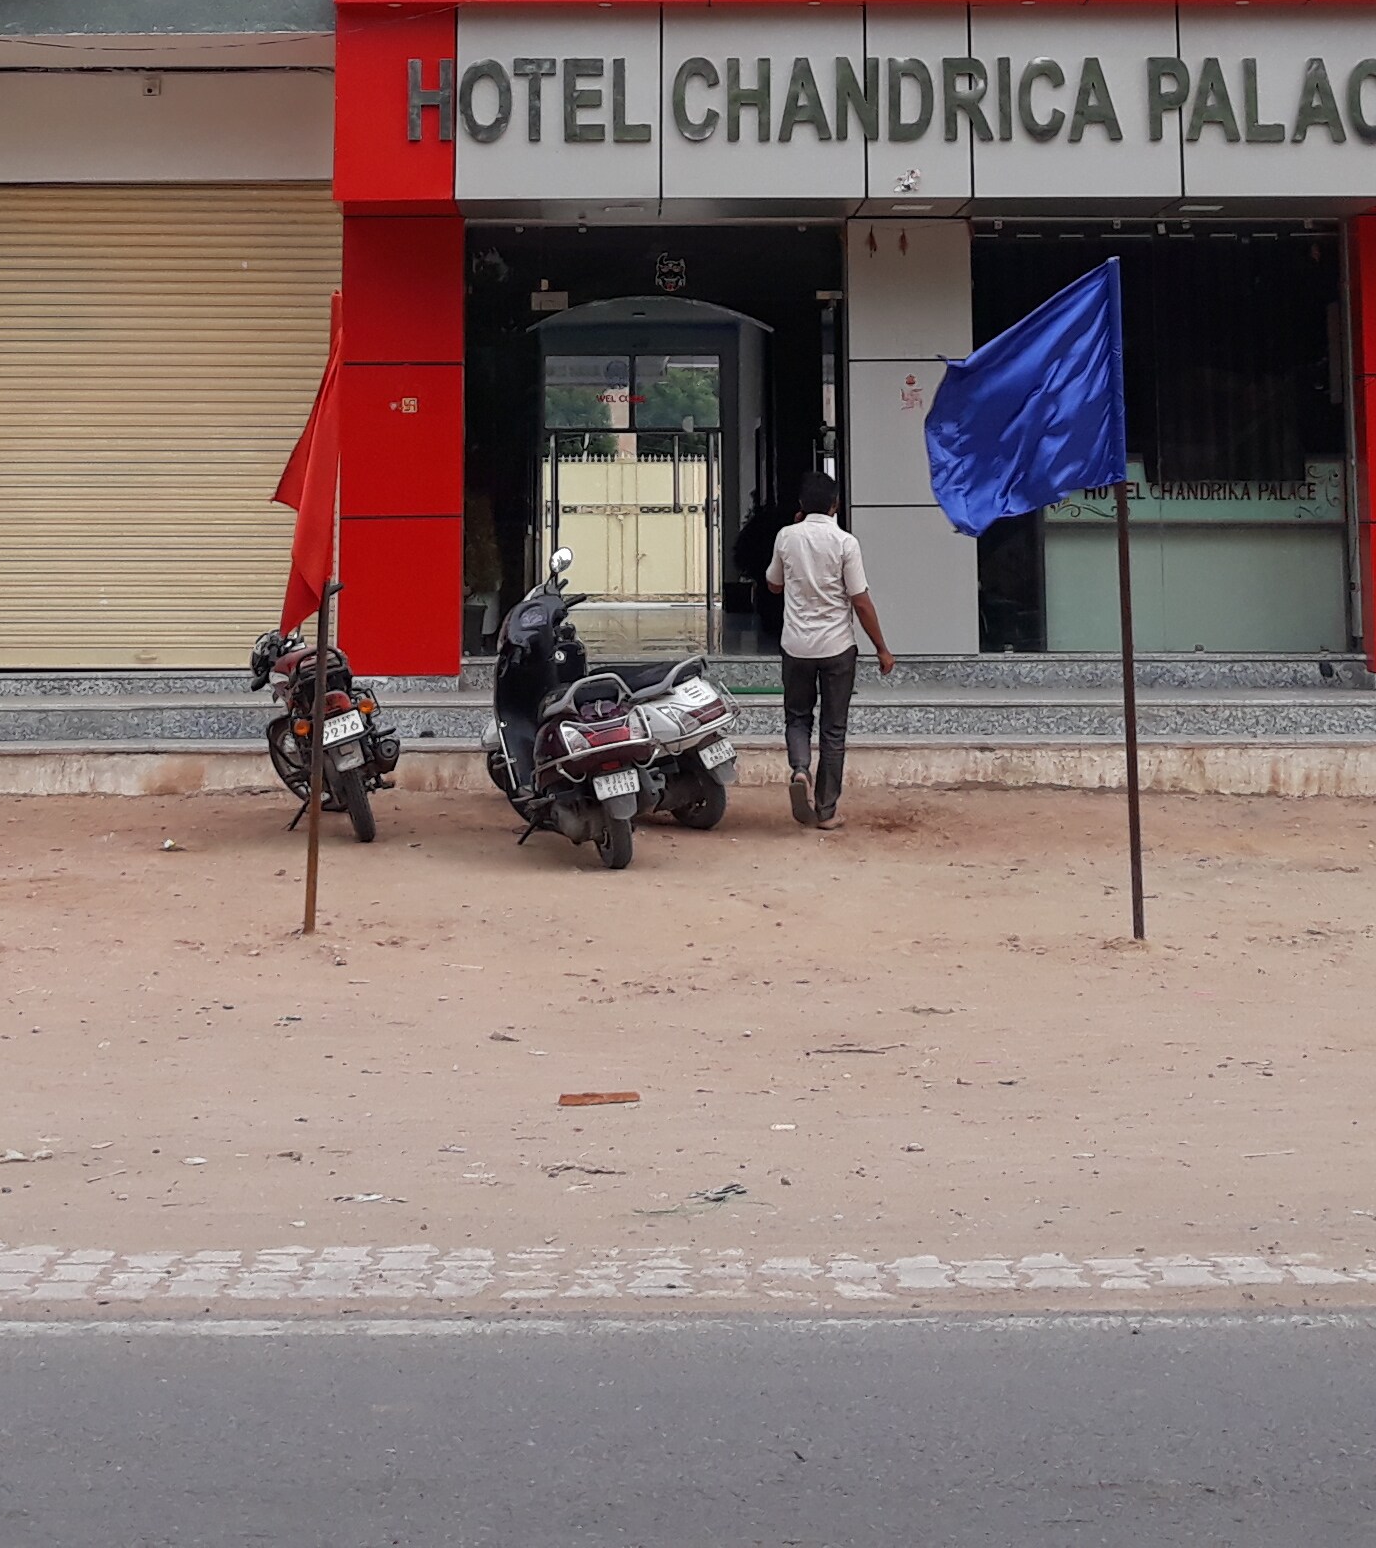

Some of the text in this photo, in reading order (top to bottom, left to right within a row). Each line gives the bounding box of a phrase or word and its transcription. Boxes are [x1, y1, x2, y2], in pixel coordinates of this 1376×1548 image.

[407, 57, 652, 143] HOTEL
[671, 56, 1124, 143] CHANDRICA
[1083, 481, 1317, 501] HOEL CHANDRIKA PALACE
